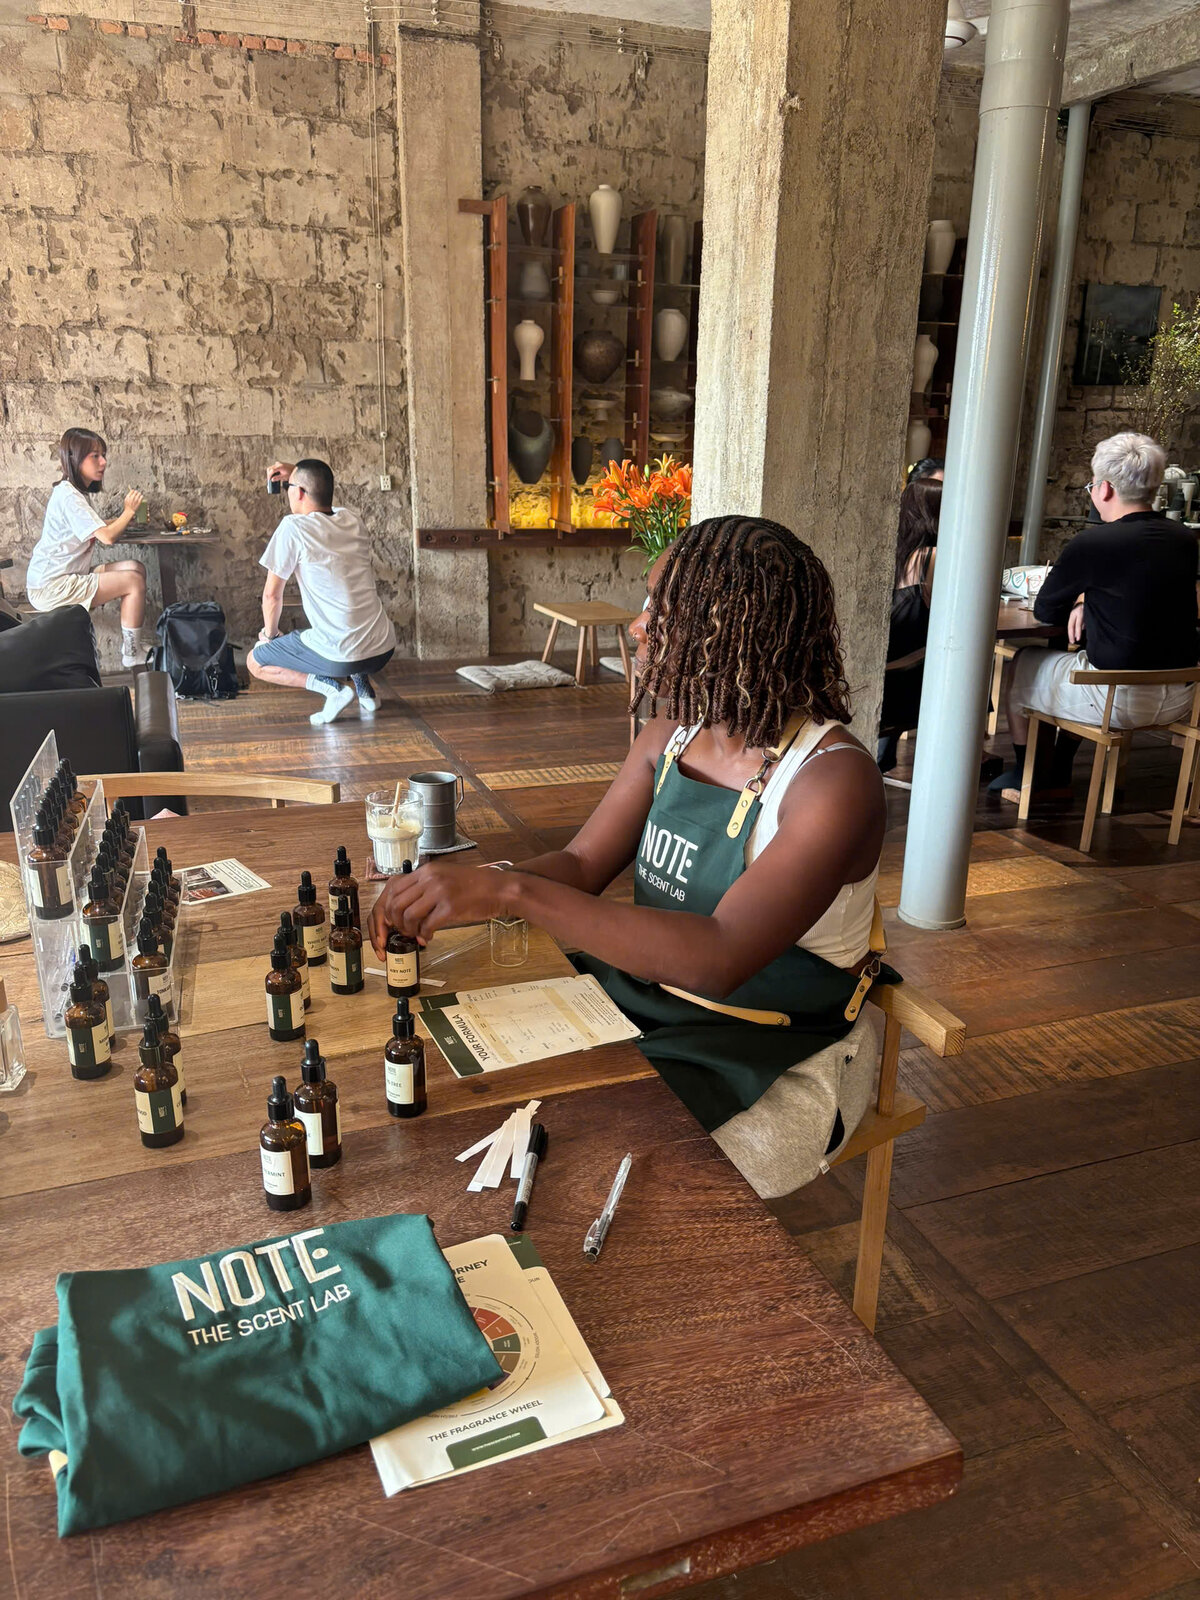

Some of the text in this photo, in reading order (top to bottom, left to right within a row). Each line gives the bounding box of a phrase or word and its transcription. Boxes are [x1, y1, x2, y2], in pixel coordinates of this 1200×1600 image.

[640, 820, 699, 884] NOTE
[638, 863, 686, 902] THE SCENT LAB
[452, 1013, 490, 1062] YOUR FORMULA
[170, 1228, 342, 1322] NOTE
[187, 1283, 351, 1346] THE SCENT LAB
[427, 1431, 448, 1442] THE
[450, 1411, 508, 1435] FRAGRANCE
[509, 1399, 543, 1415] WHEEL
